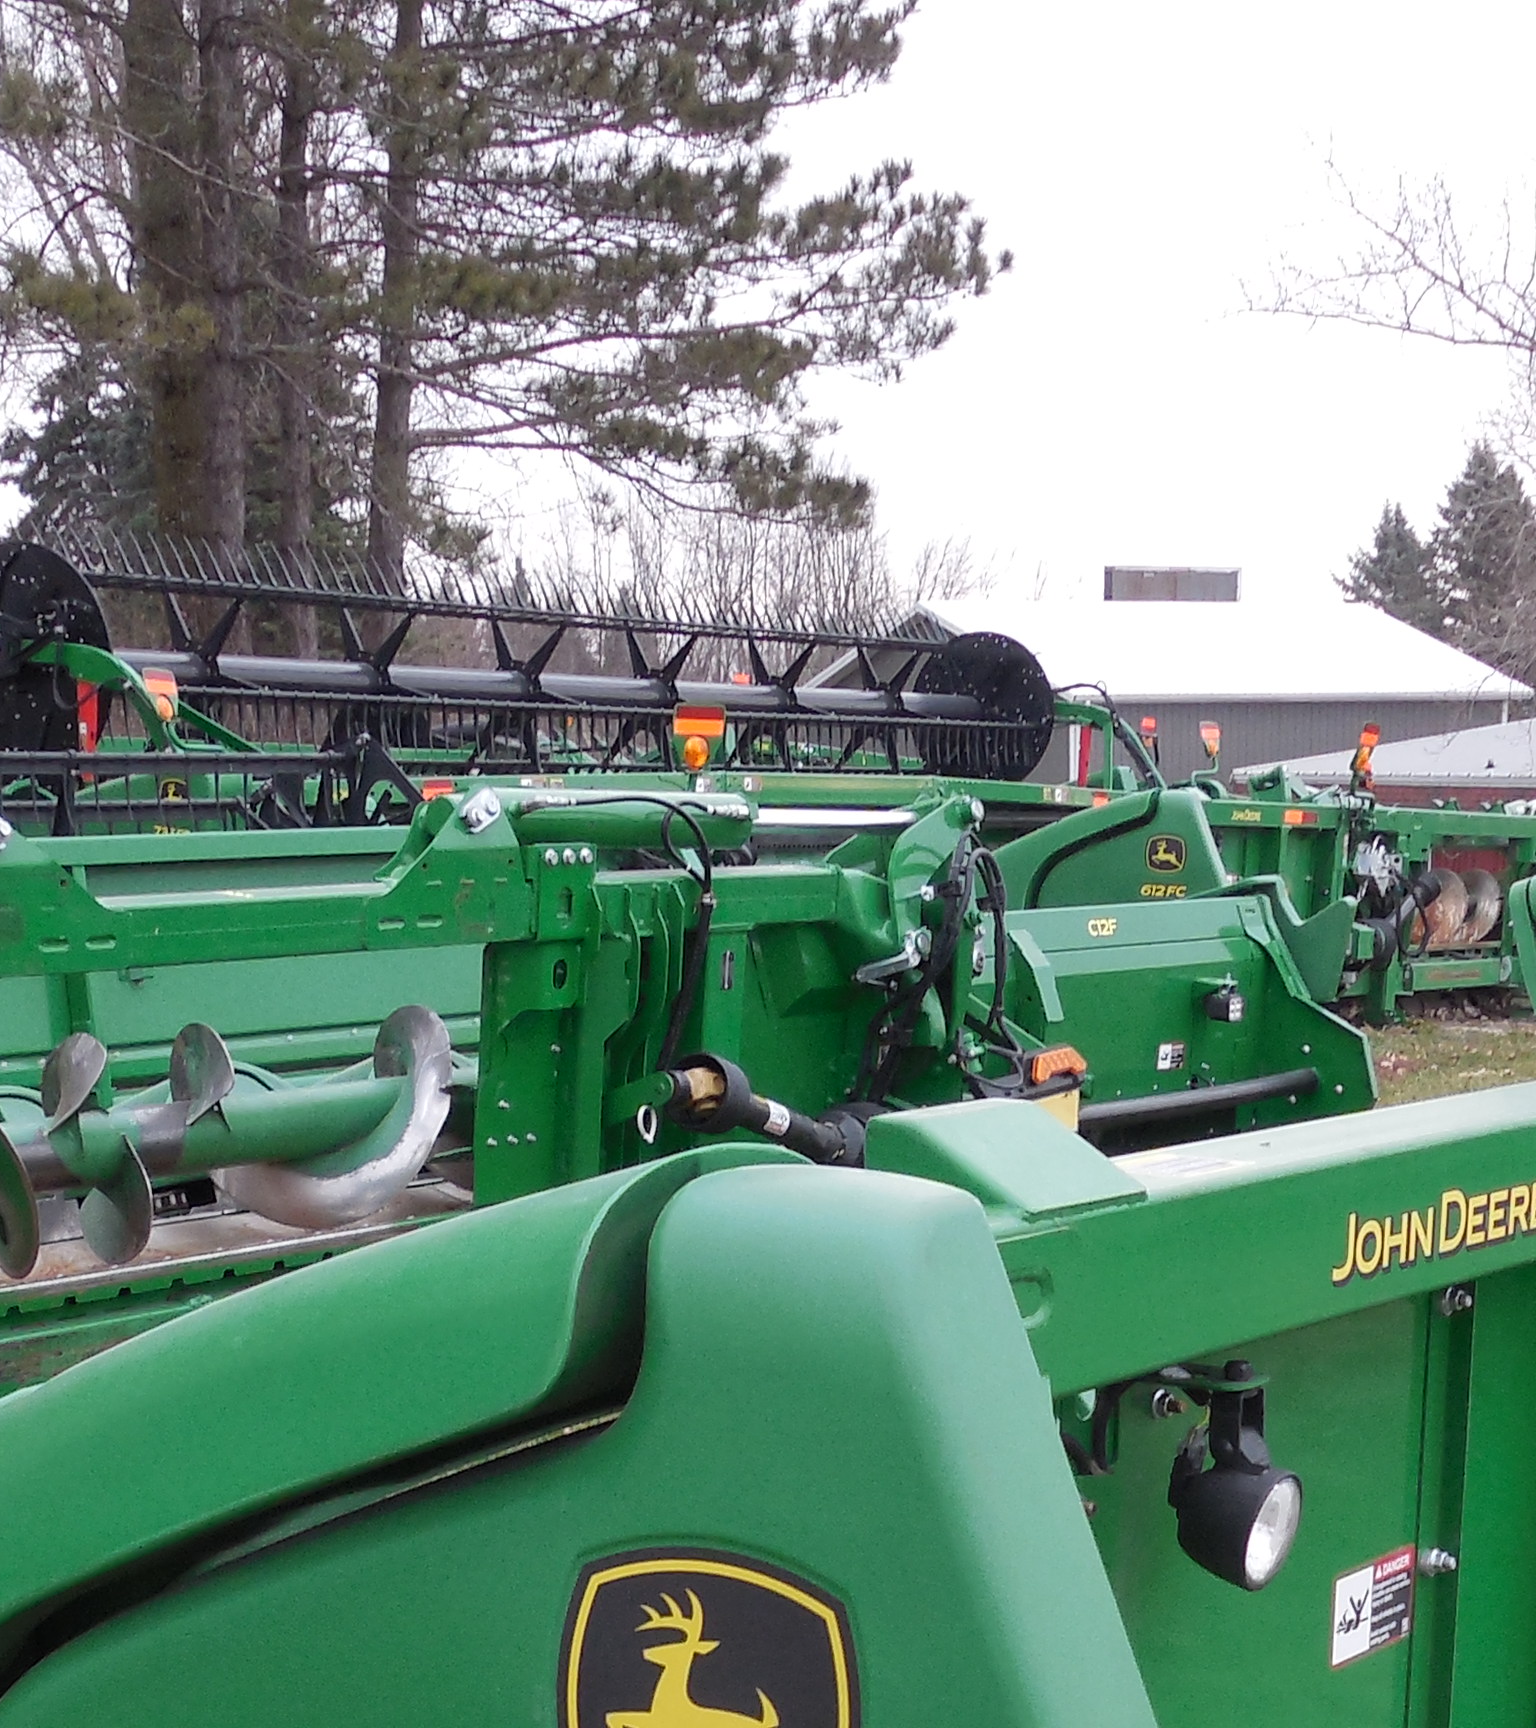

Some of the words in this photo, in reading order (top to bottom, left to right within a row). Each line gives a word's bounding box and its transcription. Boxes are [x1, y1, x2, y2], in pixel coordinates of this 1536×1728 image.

[1140, 884, 1166, 897] 612
[1166, 885, 1188, 898] FC
[1087, 918, 1117, 937] C12F
[1331, 1206, 1436, 1286] JOHN
